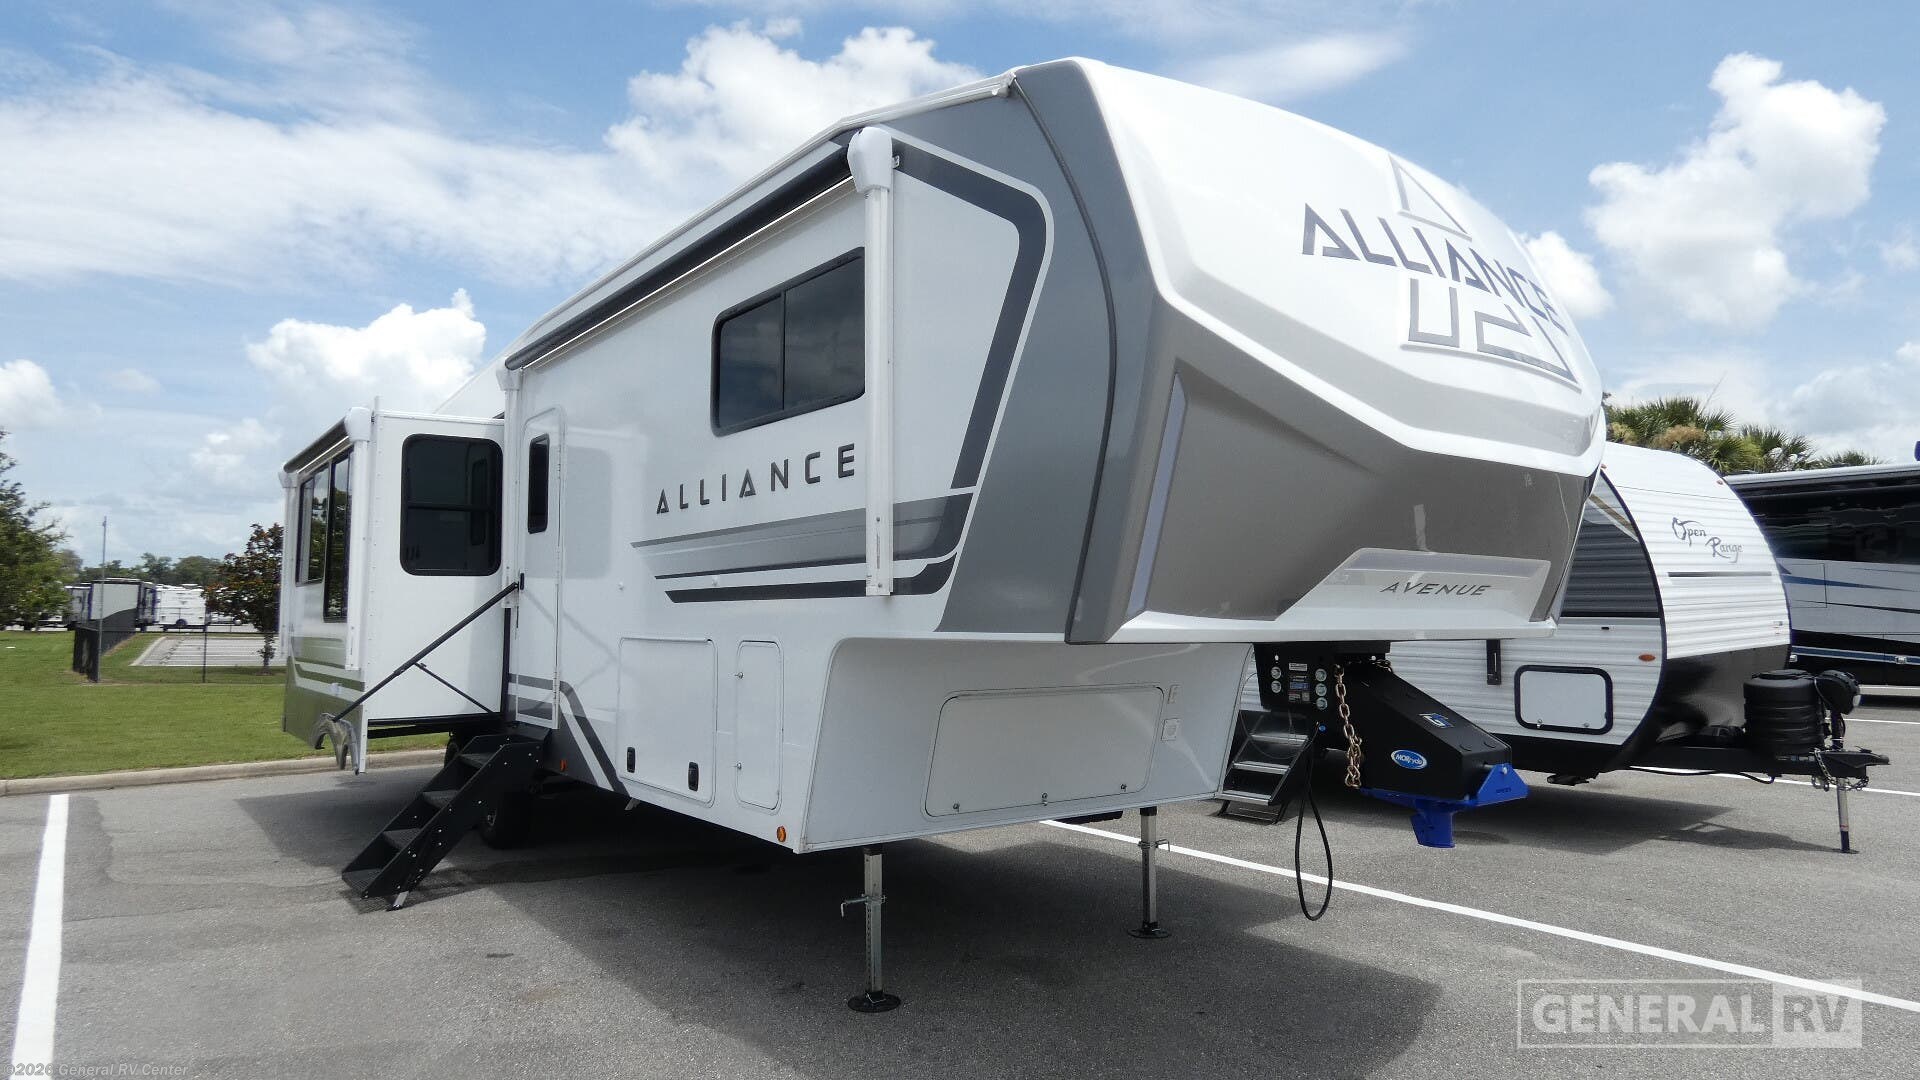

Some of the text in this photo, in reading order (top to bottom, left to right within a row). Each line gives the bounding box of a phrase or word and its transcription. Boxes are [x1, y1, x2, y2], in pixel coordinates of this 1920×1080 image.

[1302, 203, 1569, 336] ALLIANCE
[656, 443, 855, 514] ALLIANCE
[1672, 517, 1707, 547] Open
[1704, 537, 1744, 563] Range
[1379, 582, 1492, 596] AVENUE
